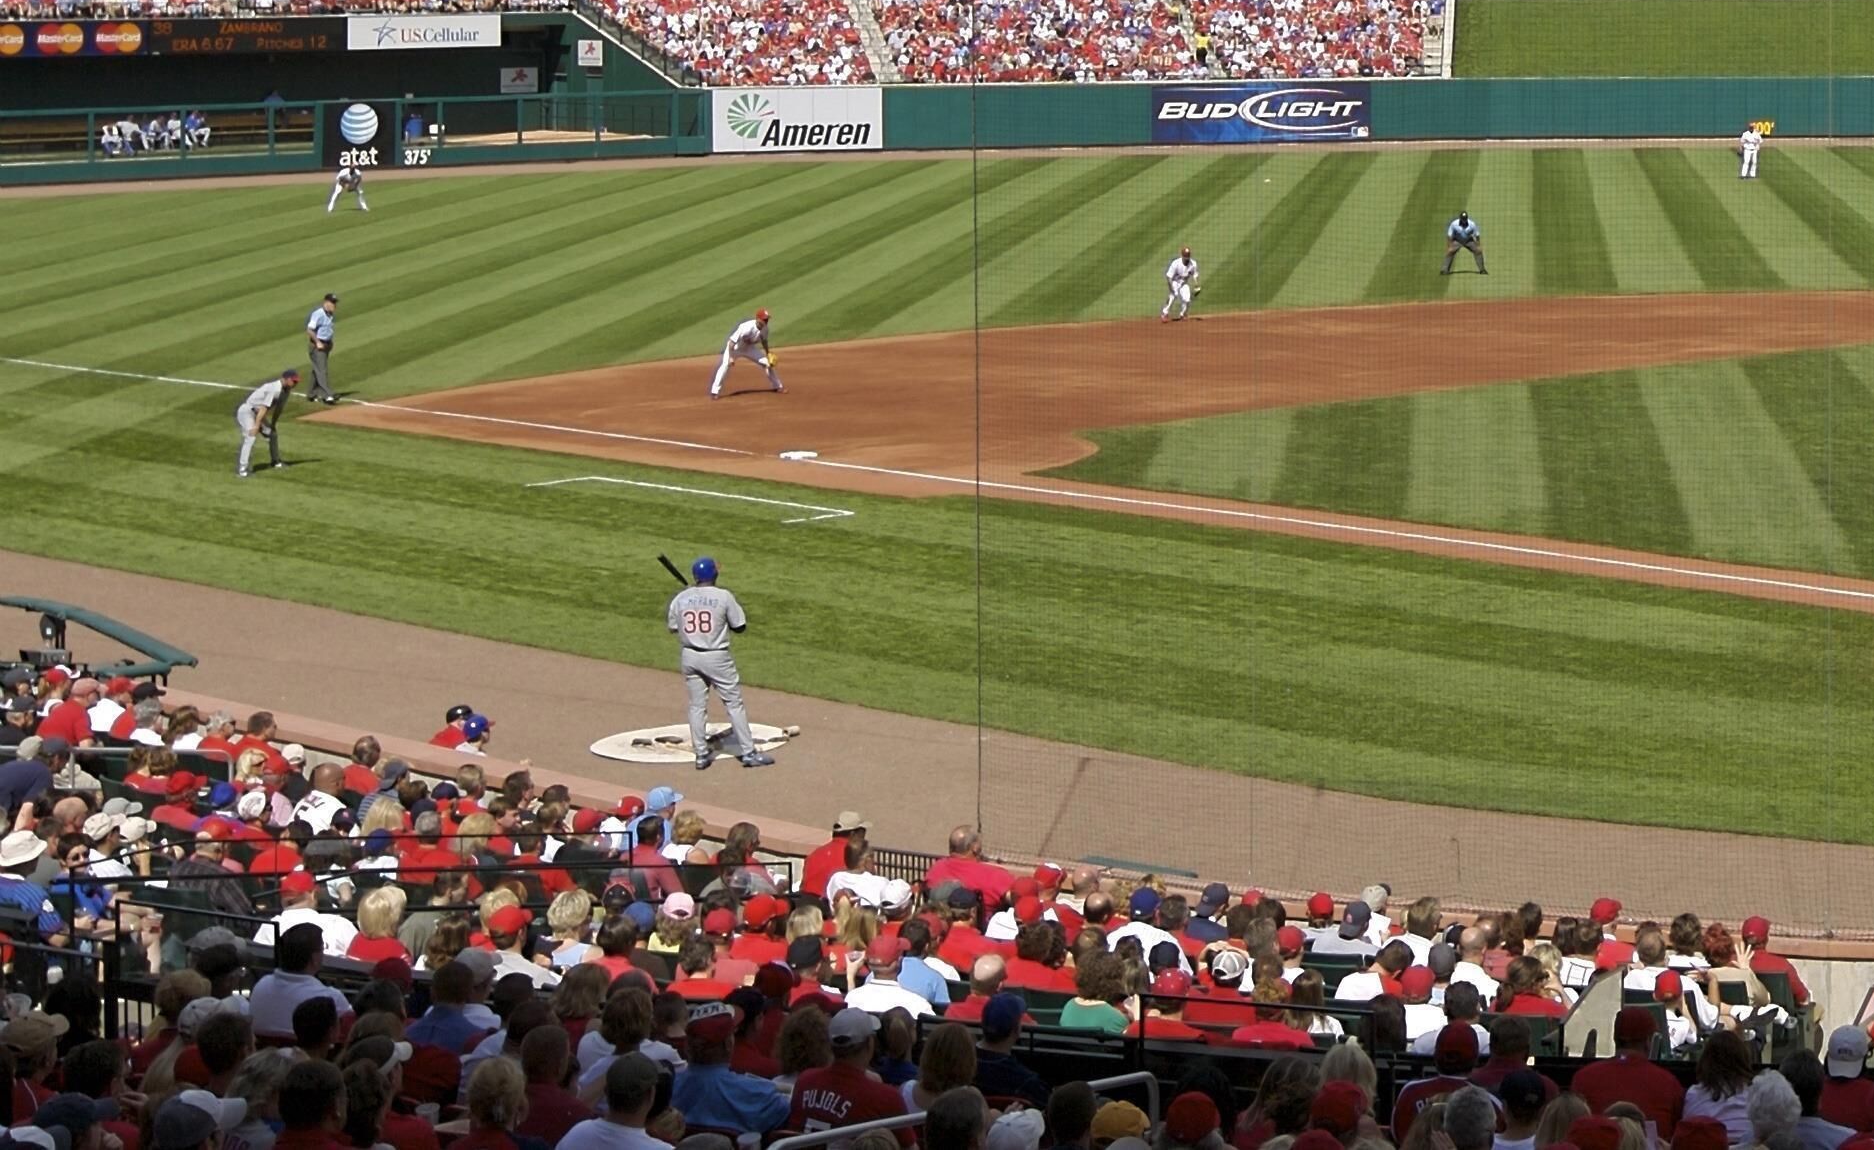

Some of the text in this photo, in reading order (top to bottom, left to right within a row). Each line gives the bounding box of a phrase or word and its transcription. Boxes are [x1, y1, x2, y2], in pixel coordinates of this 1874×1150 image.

[38, 33, 83, 44] MasterCard
[154, 23, 172, 35] 38
[1158, 101, 1363, 120] BUD LIGHT
[760, 119, 871, 147] Ameren
[339, 147, 378, 166] at&t
[404, 149, 431, 165] 375'
[683, 611, 713, 635] 38
[802, 1090, 852, 1119] PUJOLS
